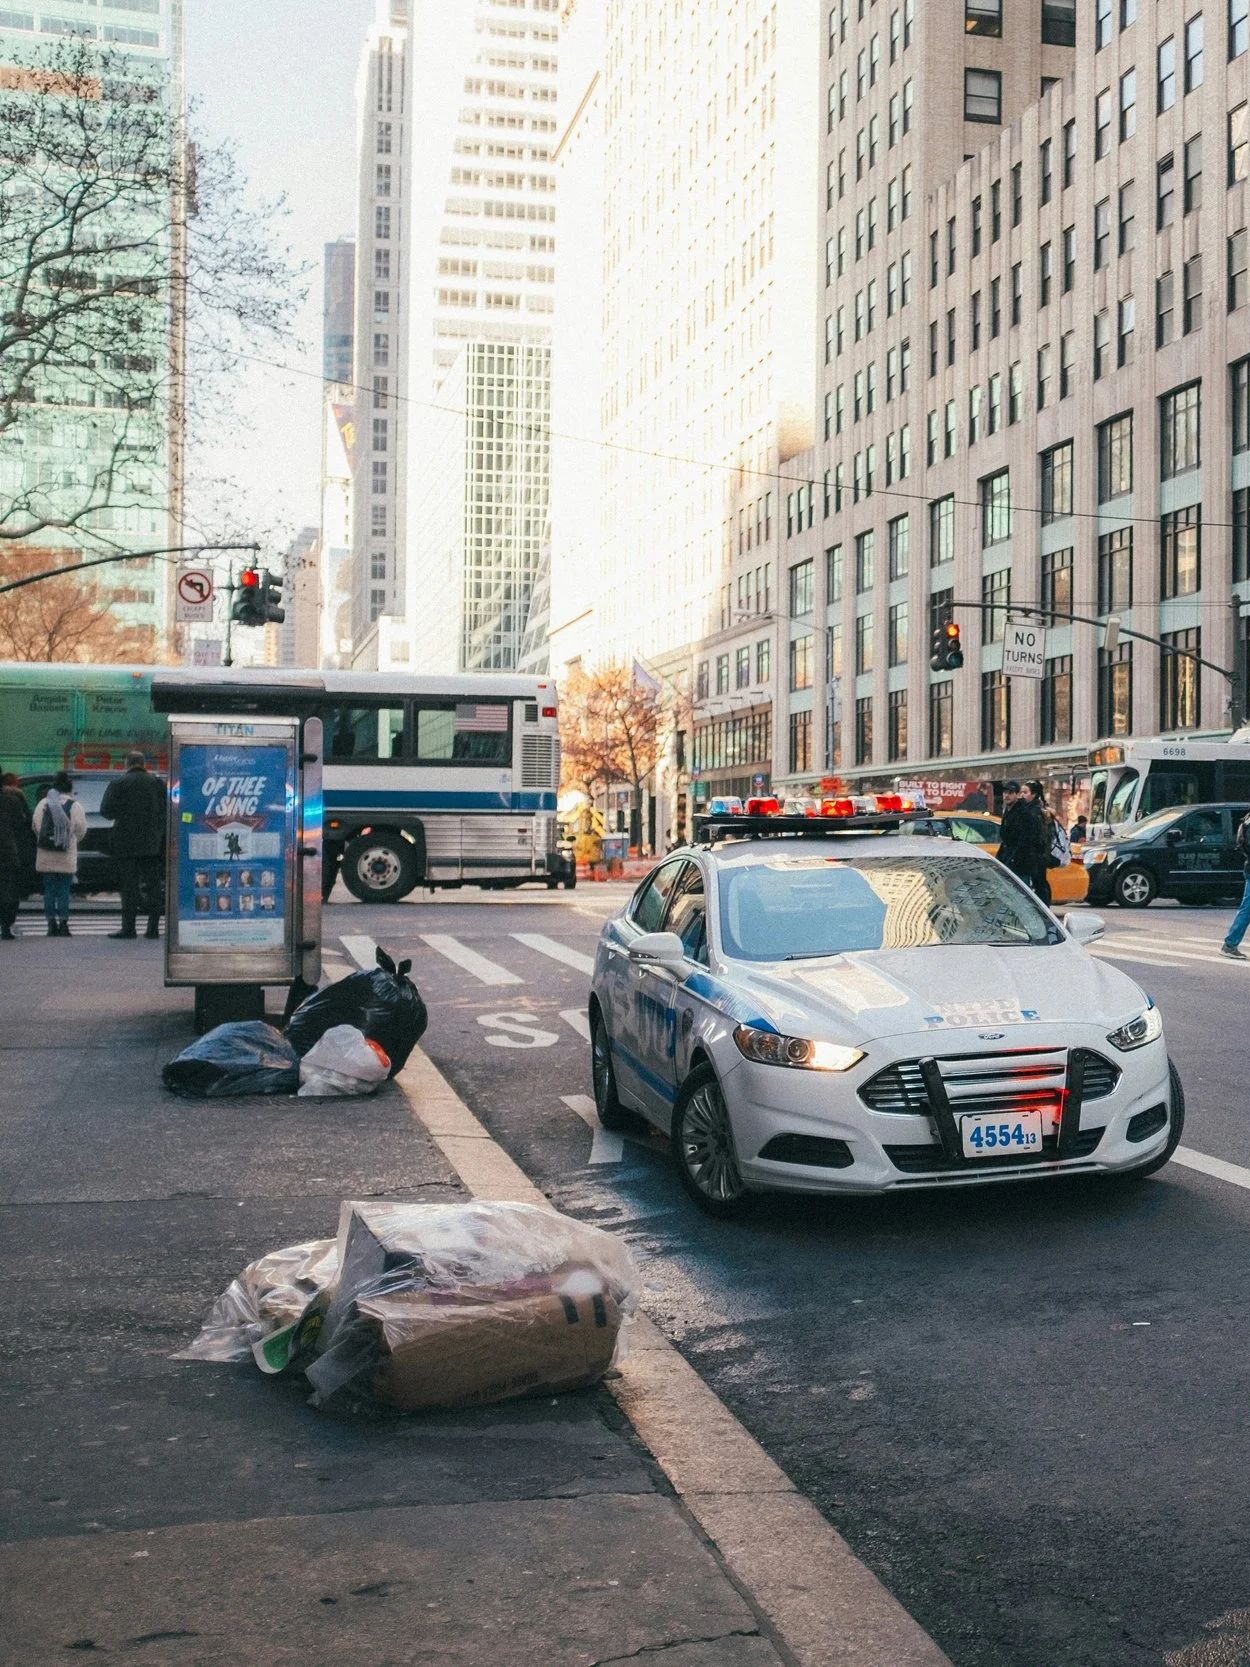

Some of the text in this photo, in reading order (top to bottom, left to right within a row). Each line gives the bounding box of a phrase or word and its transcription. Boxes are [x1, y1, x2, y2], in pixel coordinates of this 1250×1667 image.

[1015, 632, 1036, 647] NO
[1005, 650, 1043, 665] TURNS
[215, 724, 255, 735] TITAN
[1163, 748, 1186, 756] 6698
[202, 776, 267, 796] OF THEE
[940, 782, 967, 790] FIGHT
[940, 789, 965, 797] LOVE
[205, 796, 259, 817] I SING
[924, 1010, 1041, 1028] POLICE
[969, 1123, 1037, 1148] 4554 13
